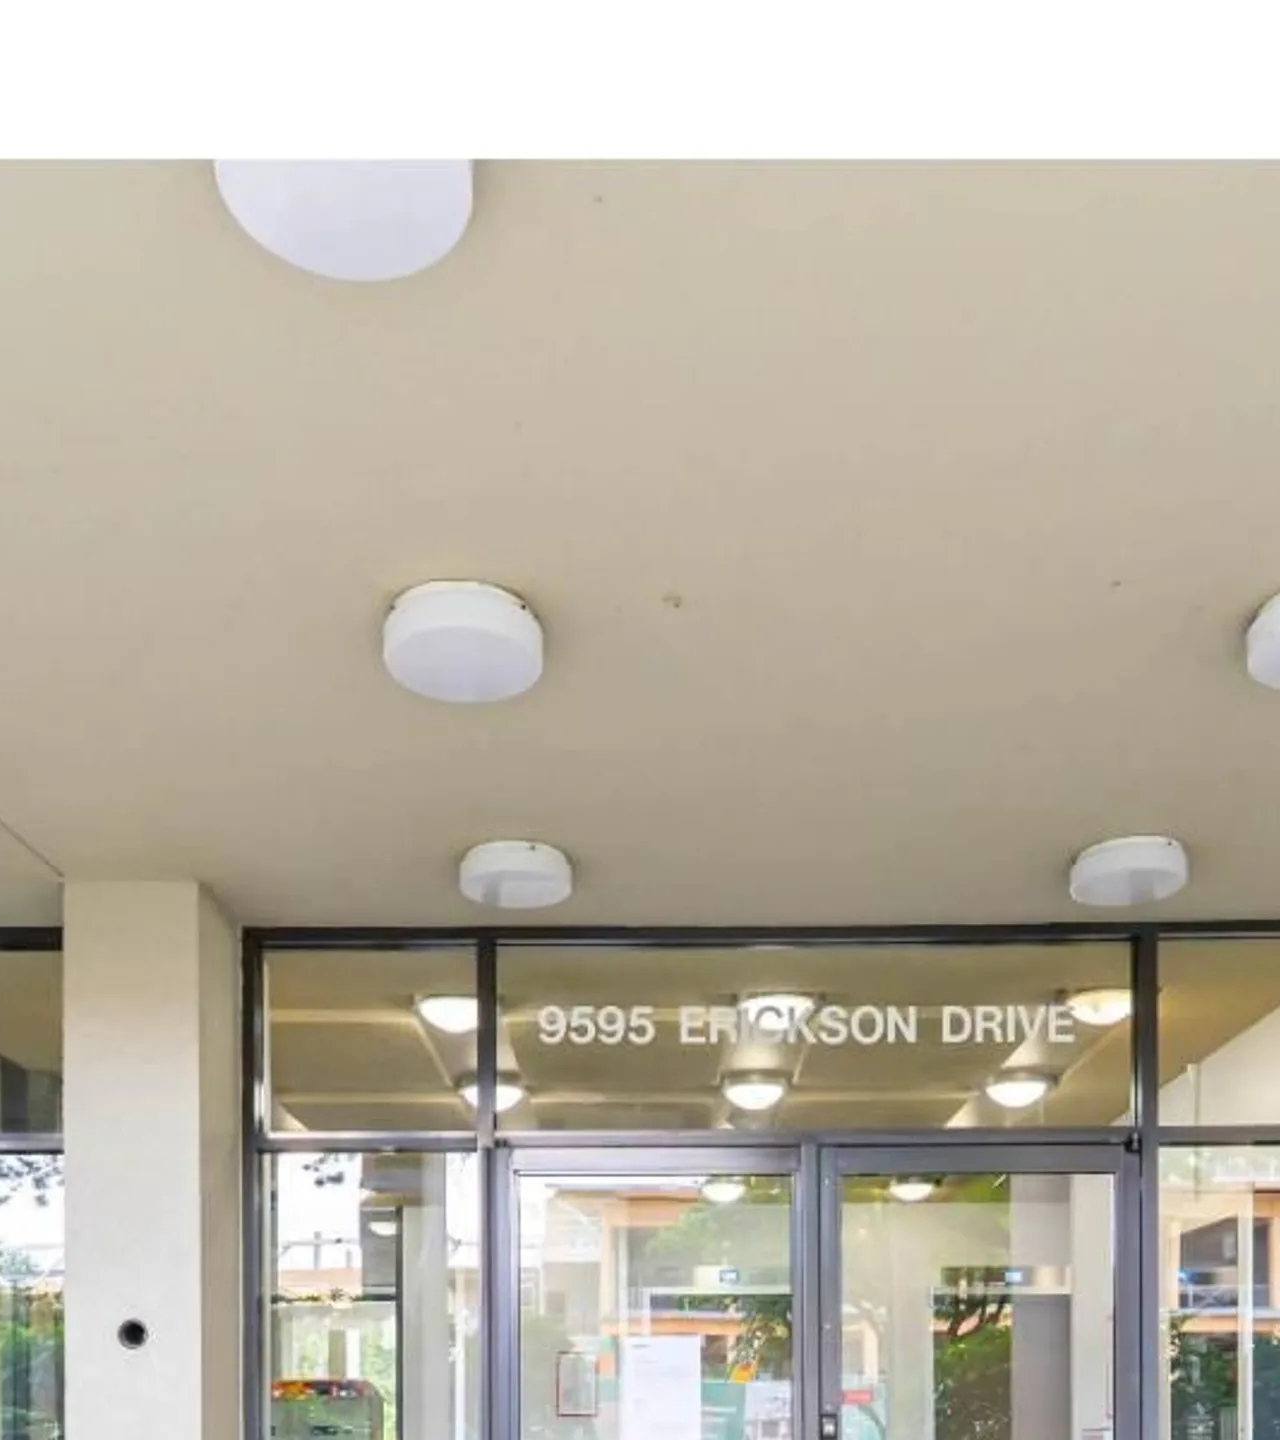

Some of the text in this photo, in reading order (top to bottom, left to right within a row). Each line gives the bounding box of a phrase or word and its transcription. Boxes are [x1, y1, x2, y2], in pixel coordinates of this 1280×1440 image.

[537, 1004, 1076, 1045] 9595 ERICKSON DRIVE
